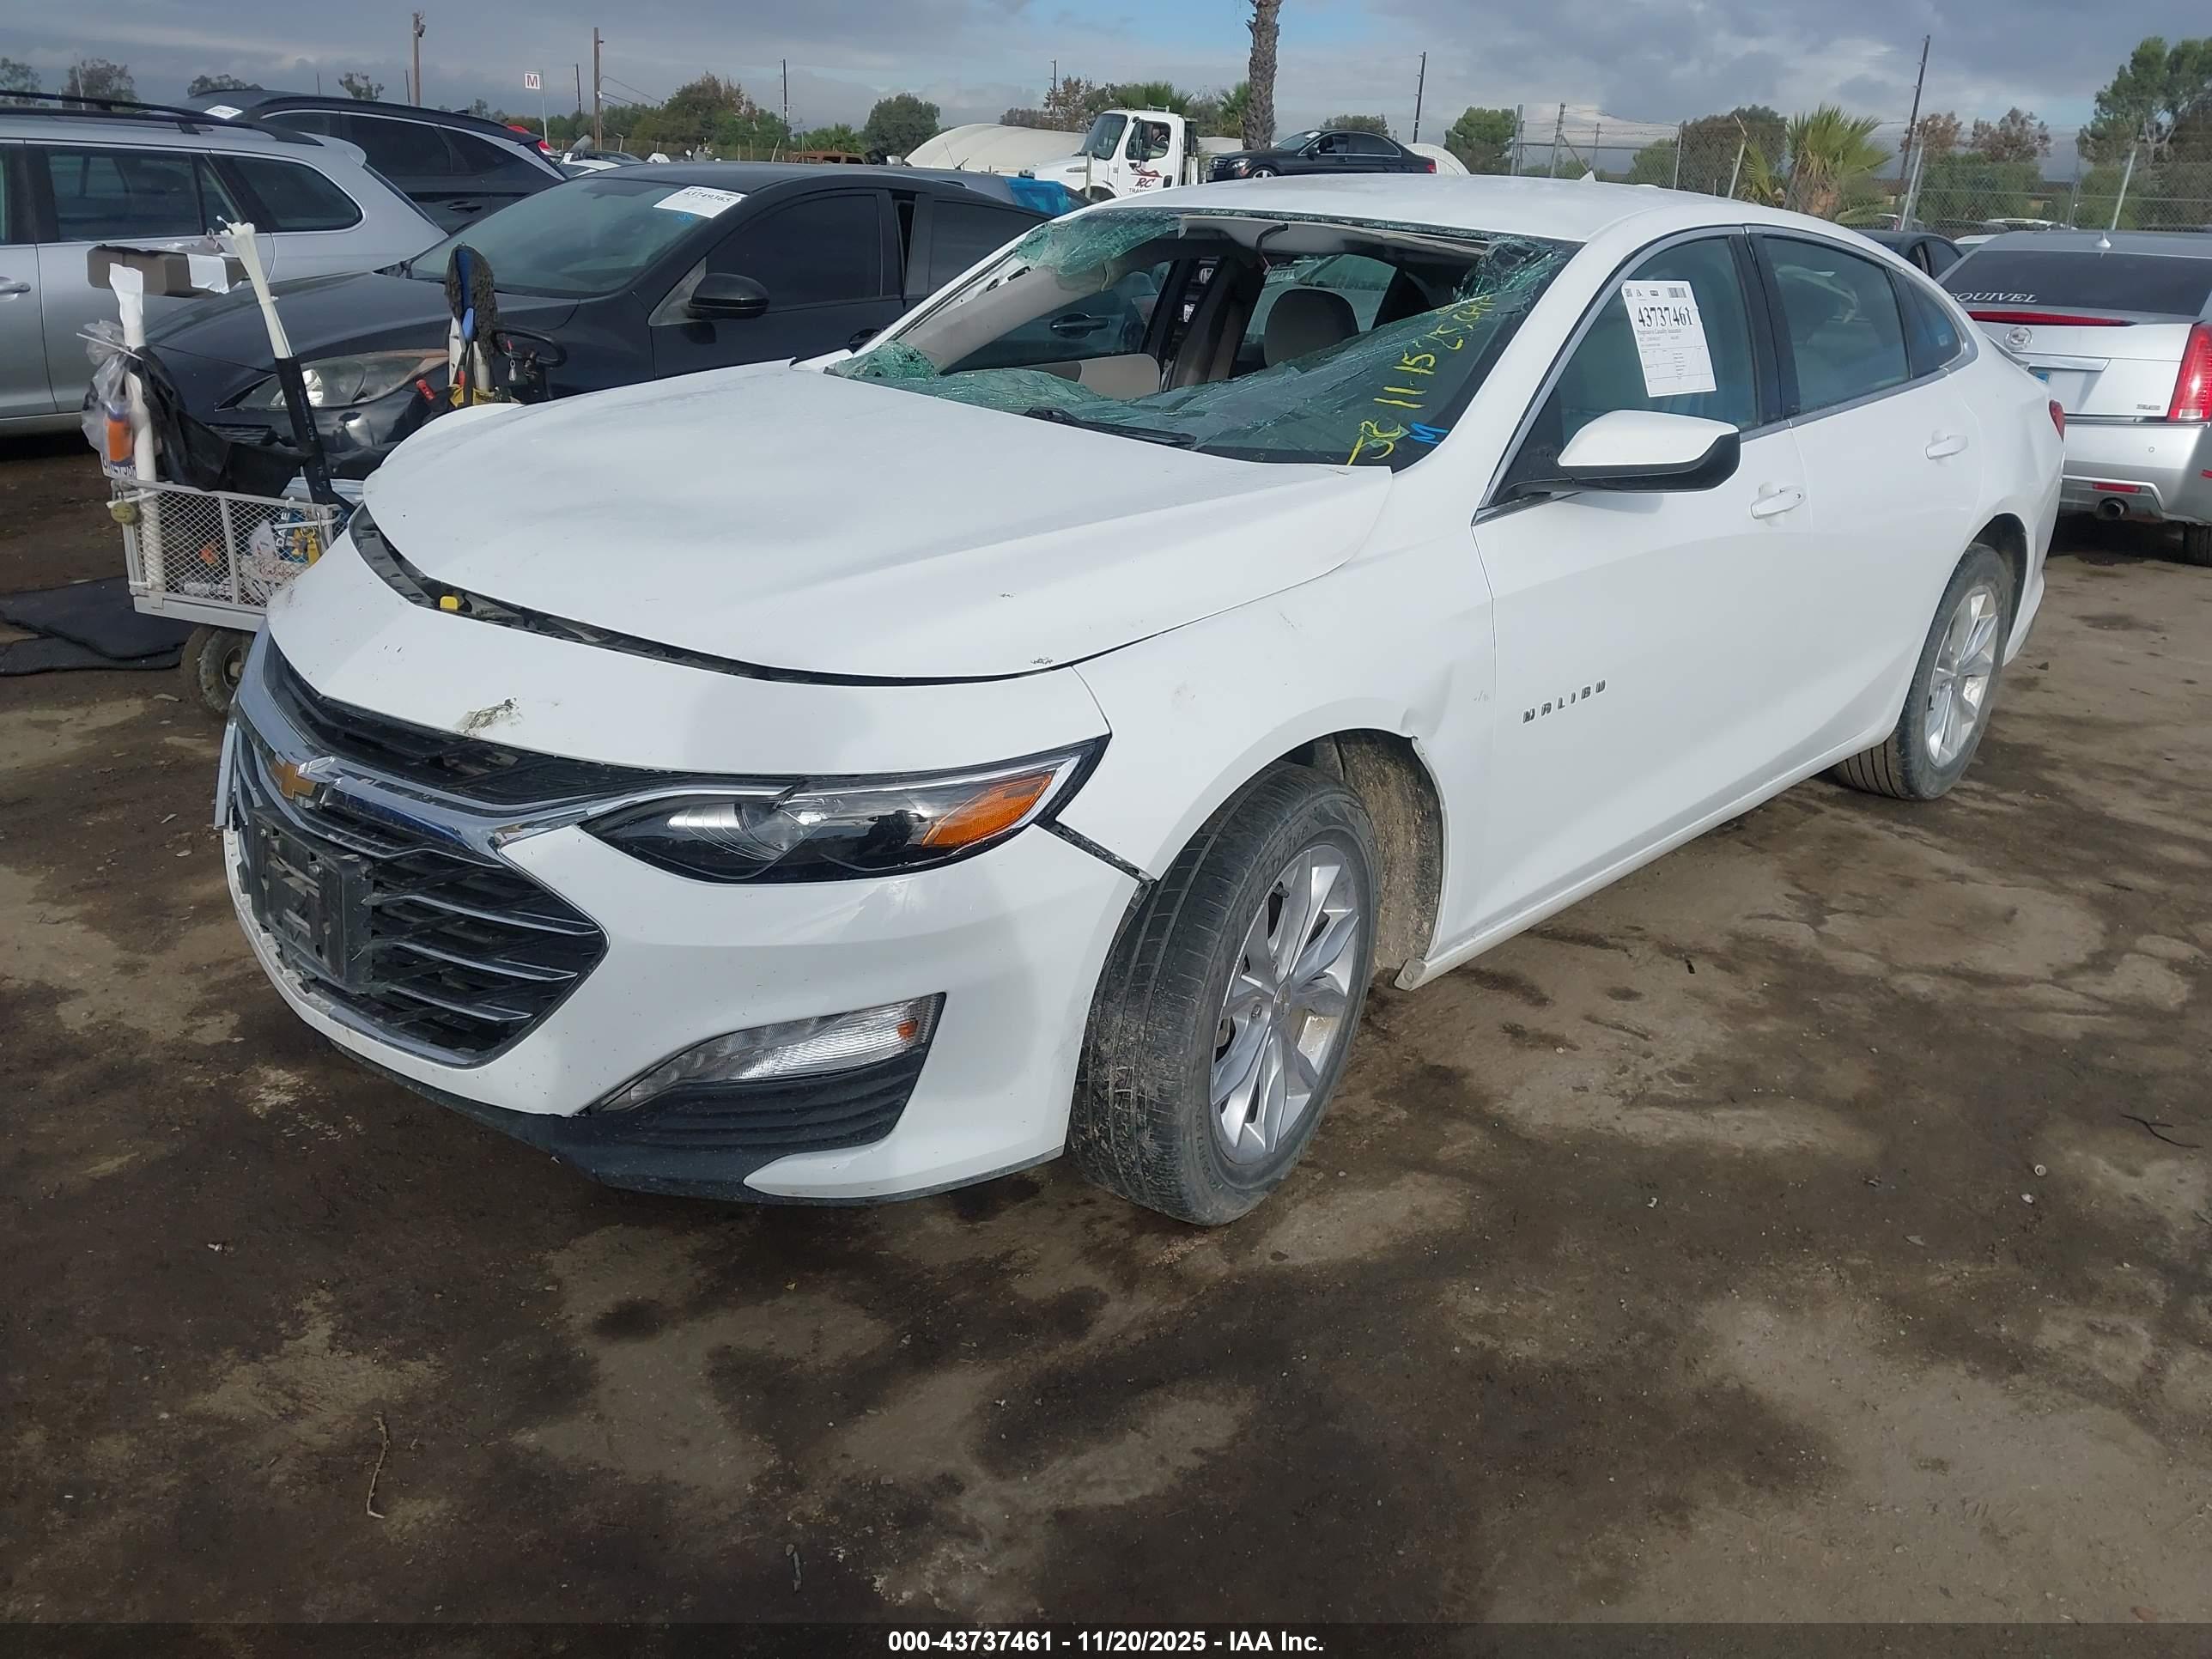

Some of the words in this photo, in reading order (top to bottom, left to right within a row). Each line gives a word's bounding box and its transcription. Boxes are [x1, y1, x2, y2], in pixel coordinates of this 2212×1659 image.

[526, 74, 538, 88] M
[1638, 307, 1694, 327] 43737461
[1522, 679, 1606, 724] MALIBU
